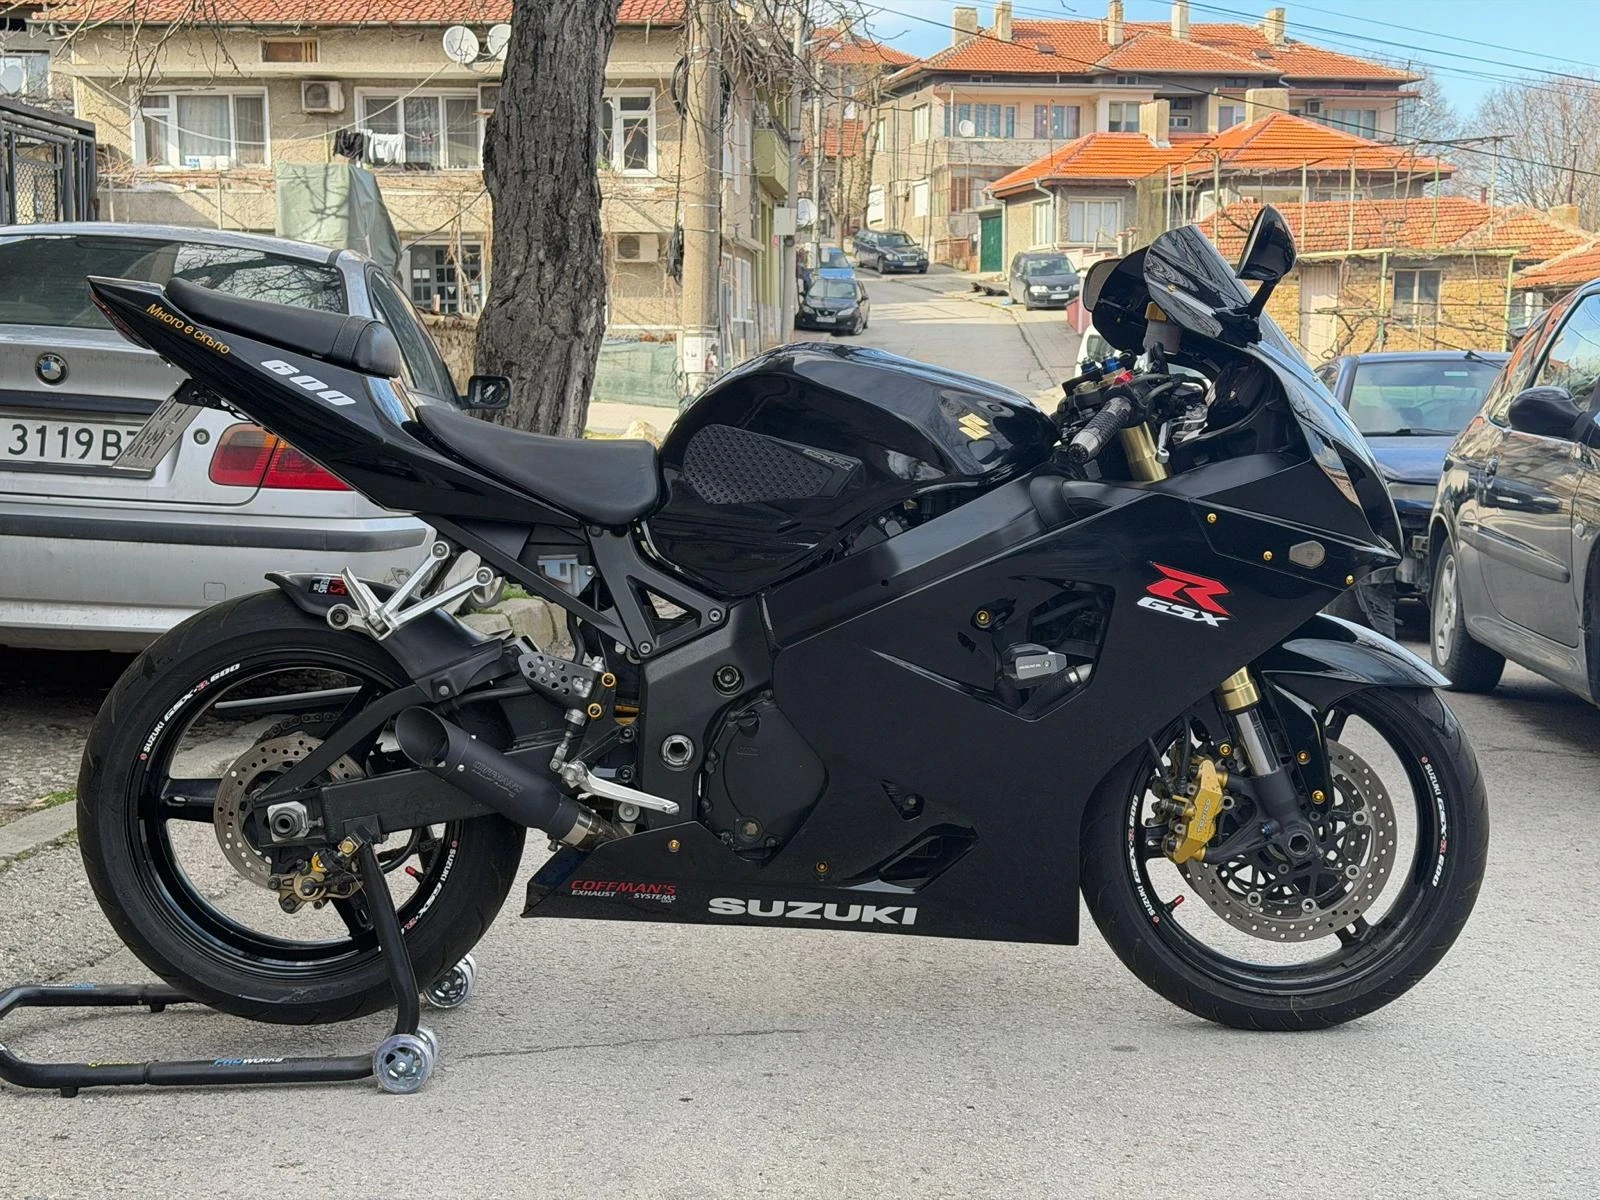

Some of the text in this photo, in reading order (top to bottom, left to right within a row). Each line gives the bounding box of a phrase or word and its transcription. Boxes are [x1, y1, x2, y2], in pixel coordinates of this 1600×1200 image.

[146, 303, 230, 354] Много е скъпо
[260, 359, 357, 406] 600
[1136, 596, 1230, 627] GSX
[143, 721, 165, 753] SUZUKI
[210, 663, 241, 682] 600
[1424, 763, 1442, 796] SUZUKI
[1129, 794, 1139, 827] 600
[440, 848, 457, 882] SUZUKI
[1432, 854, 1445, 887] 600
[571, 880, 677, 894] COFFMAN'S
[633, 893, 677, 901] SYSTEMS
[1137, 885, 1156, 917] SUZUKI
[708, 898, 918, 925] SUZUKI
